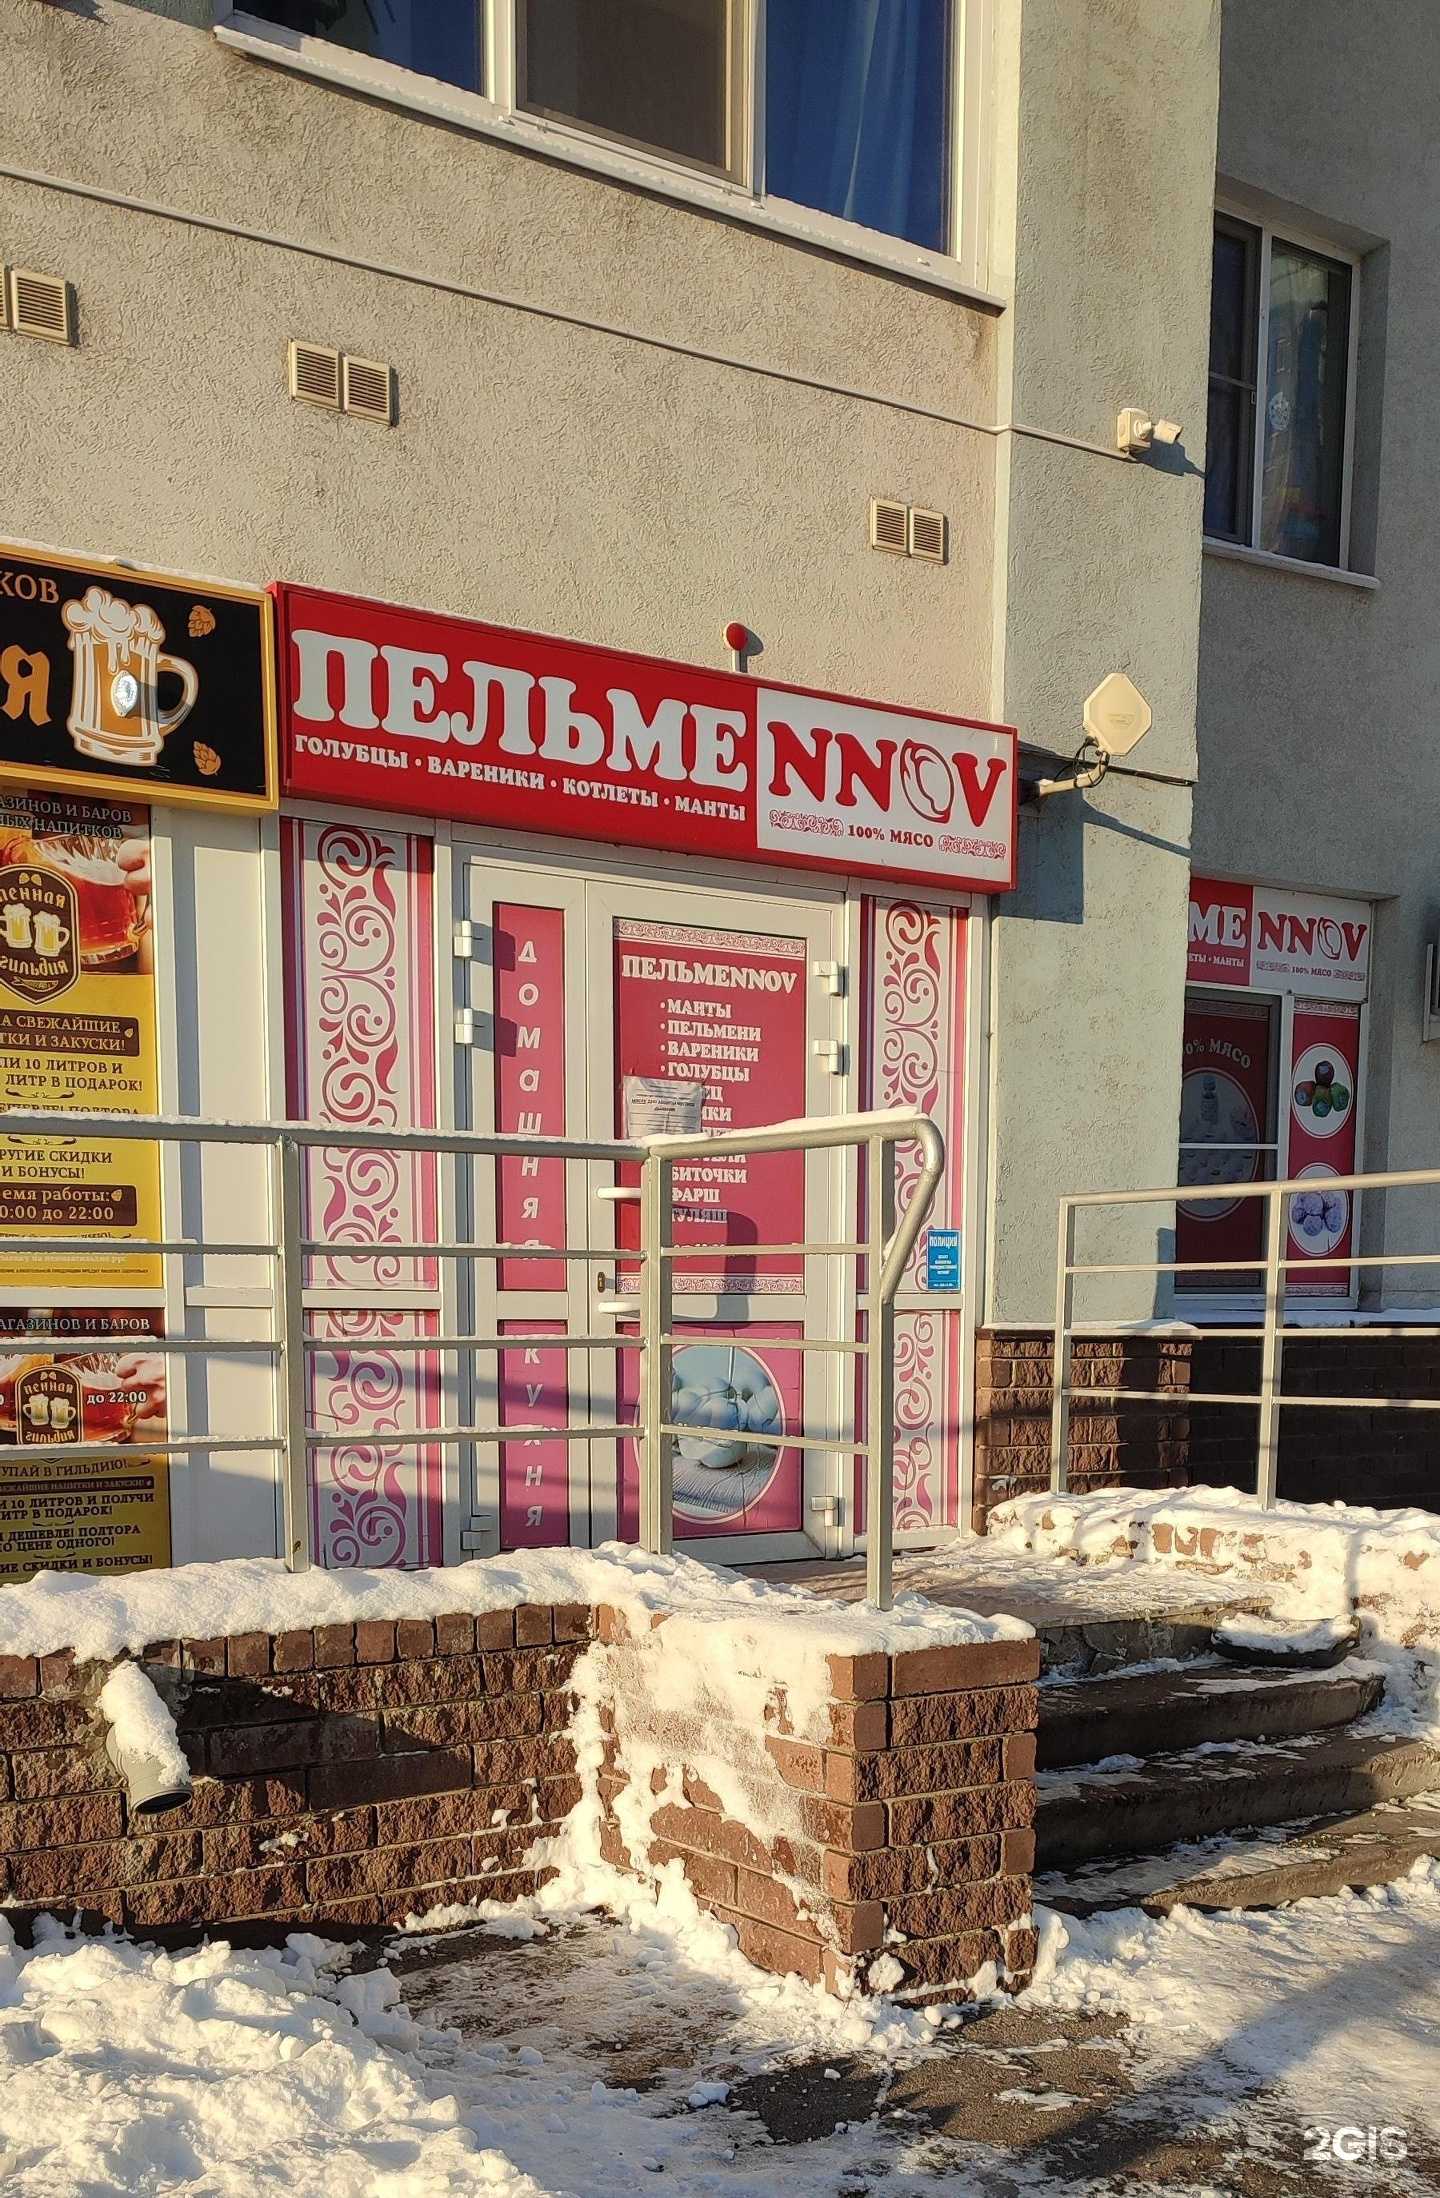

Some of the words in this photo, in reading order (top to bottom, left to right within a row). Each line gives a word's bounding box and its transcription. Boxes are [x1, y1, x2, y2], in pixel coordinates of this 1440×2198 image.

[295, 734, 408, 769] ГОЛУБЦЫ
[427, 756, 545, 790] ВАРЕНИКИ
[563, 778, 658, 808] КОТЛЕТЫ
[674, 795, 746, 821] МАНТЫ
[66, 804, 78, 817] И
[81, 805, 131, 823] БАРОВ
[34, 818, 122, 839] НАПИТКОВ
[847, 825, 885, 841] 100%
[890, 829, 933, 848] МЯСО
[1212, 954, 1244, 967] МАНТЫ
[1310, 967, 1332, 977] МЯСО
[667, 999, 731, 1018] МАНТЫ
[16, 1014, 120, 1034] СВЕЖАЙШИЕ
[667, 1019, 761, 1041] ПЕЛЬМЕНИ
[35, 1034, 47, 1047] И
[50, 1035, 126, 1051] ЗАКУСКИ!
[667, 1041, 759, 1062] ВАРЕНИКИ
[1209, 1038, 1251, 1068] МЯСО
[26, 1058, 41, 1070] 10
[46, 1059, 108, 1073] ЛИТРОВ
[112, 1063, 123, 1074] И
[667, 1062, 749, 1083] ГОЛУБЦЫ
[5, 1074, 47, 1087] ЛИТР
[51, 1076, 60, 1087] В
[65, 1077, 143, 1091] ПОДАРОК!
[49, 1150, 113, 1165] СКИДКИ
[17, 1166, 85, 1179] БОНУСЫ!
[41, 1186, 110, 1204] работы:
[41, 1208, 63, 1221] до
[68, 1206, 114, 1220] 22:00
[85, 1318, 97, 1330] И
[100, 1318, 150, 1330] БАРОВ
[87, 1394, 105, 1405] до
[108, 1391, 147, 1404] 22:00
[44, 1466, 52, 1476] В
[56, 1458, 128, 1476] ГИЛЬДИЮ!
[12, 1499, 25, 1509] 10
[29, 1496, 83, 1508] ЛИТРОВ
[88, 1495, 97, 1505] И
[102, 1493, 154, 1505] ПОЛУЧИ
[33, 1509, 41, 1519] В
[44, 1506, 112, 1520] ПОДАРОК!
[8, 1528, 74, 1542] ДЕШЕВЛЕ!
[78, 1525, 141, 1537] ПОЛТОРА
[16, 1541, 52, 1552] ЦЕНЕ
[56, 1536, 115, 1550] ОДНОГО!
[23, 1559, 78, 1572] СКИДКИ
[82, 1558, 92, 1568] И
[96, 1555, 153, 1567] БОНУСЫ!
